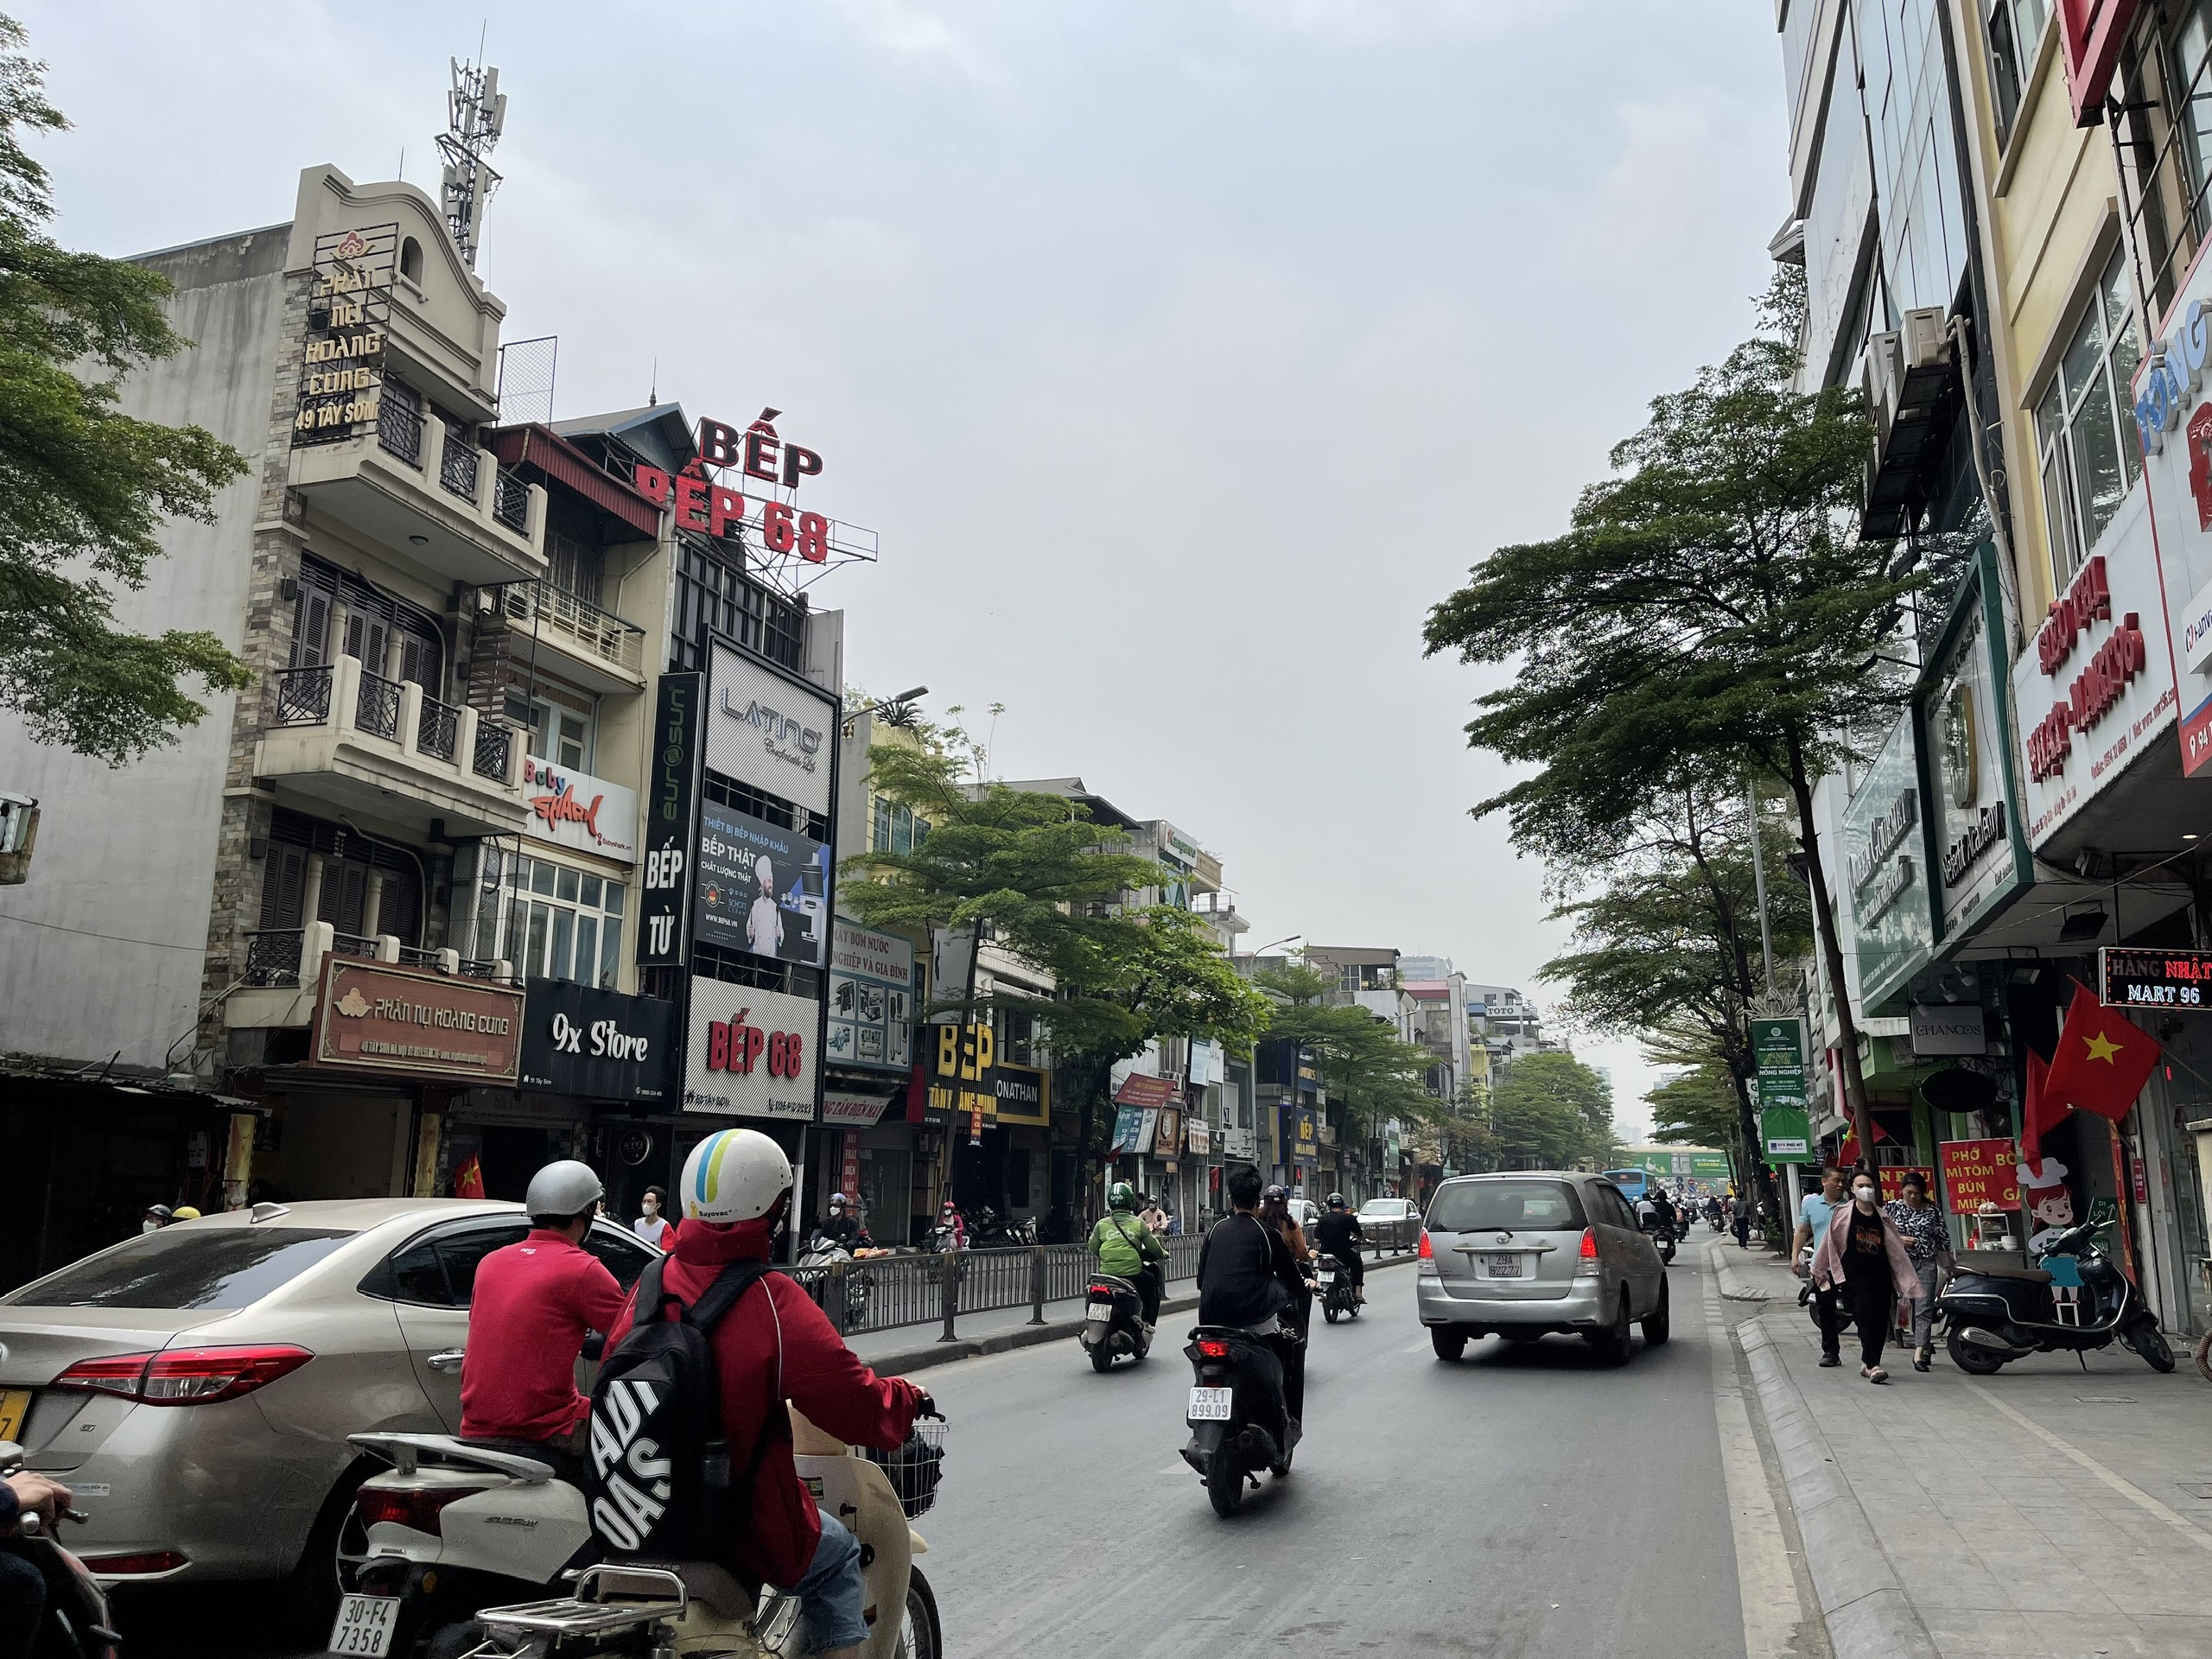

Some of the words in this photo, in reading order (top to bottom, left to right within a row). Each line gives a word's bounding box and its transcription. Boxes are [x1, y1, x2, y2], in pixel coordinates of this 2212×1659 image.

[309, 367, 371, 395] CUNG
[317, 402, 343, 429] TÂY
[699, 407, 823, 488] BẾP
[764, 501, 828, 563] 68
[524, 760, 565, 795] Baby
[529, 785, 604, 832] SHARK
[703, 816, 726, 832] THIẾT
[726, 823, 734, 838] BỊ
[734, 825, 749, 839] BẾP
[749, 833, 769, 849] NHẬP
[769, 839, 789, 855] KHẨU
[646, 836, 683, 889] BẾP
[702, 834, 726, 857] BẾP
[727, 845, 757, 871] THẬT
[701, 859, 716, 873] CHẤT
[737, 871, 752, 884] THẬT
[650, 906, 675, 956] TỪ
[850, 931, 865, 949] BƠM
[868, 936, 889, 955] NƯỚC
[832, 950, 861, 971] NGHIỆP
[863, 954, 874, 972] VÀ
[874, 961, 887, 976] GIA
[890, 963, 907, 981] ĐÌNH
[2164, 957, 2212, 984] NHẬT
[2127, 984, 2176, 1002] MART
[2180, 987, 2200, 1003] 96
[374, 995, 410, 1022] PHẤN
[413, 1004, 432, 1029] NỤ
[434, 1006, 475, 1032] HOÀNG
[477, 1015, 509, 1035] CUNG
[552, 1013, 583, 1053] 9x
[589, 1020, 648, 1062] Store
[709, 1007, 765, 1074] BẾP
[769, 1030, 803, 1079] 68
[929, 1082, 946, 1109] TÂN
[867, 1102, 885, 1119] MÁY
[1300, 1115, 1313, 1141] BẾP
[1952, 1147, 1980, 1161] PHỞ
[1995, 1151, 2016, 1166] BÒ
[1946, 1166, 1962, 1178] MÌ
[1963, 1164, 1994, 1177] TÔM
[1958, 1180, 1986, 1193] BÚN
[1496, 1255, 1513, 1265] 29A
[1196, 1389, 1224, 1403] 29-L1
[1192, 1405, 1228, 1417] 899.09
[336, 1626, 383, 1654] 7358
